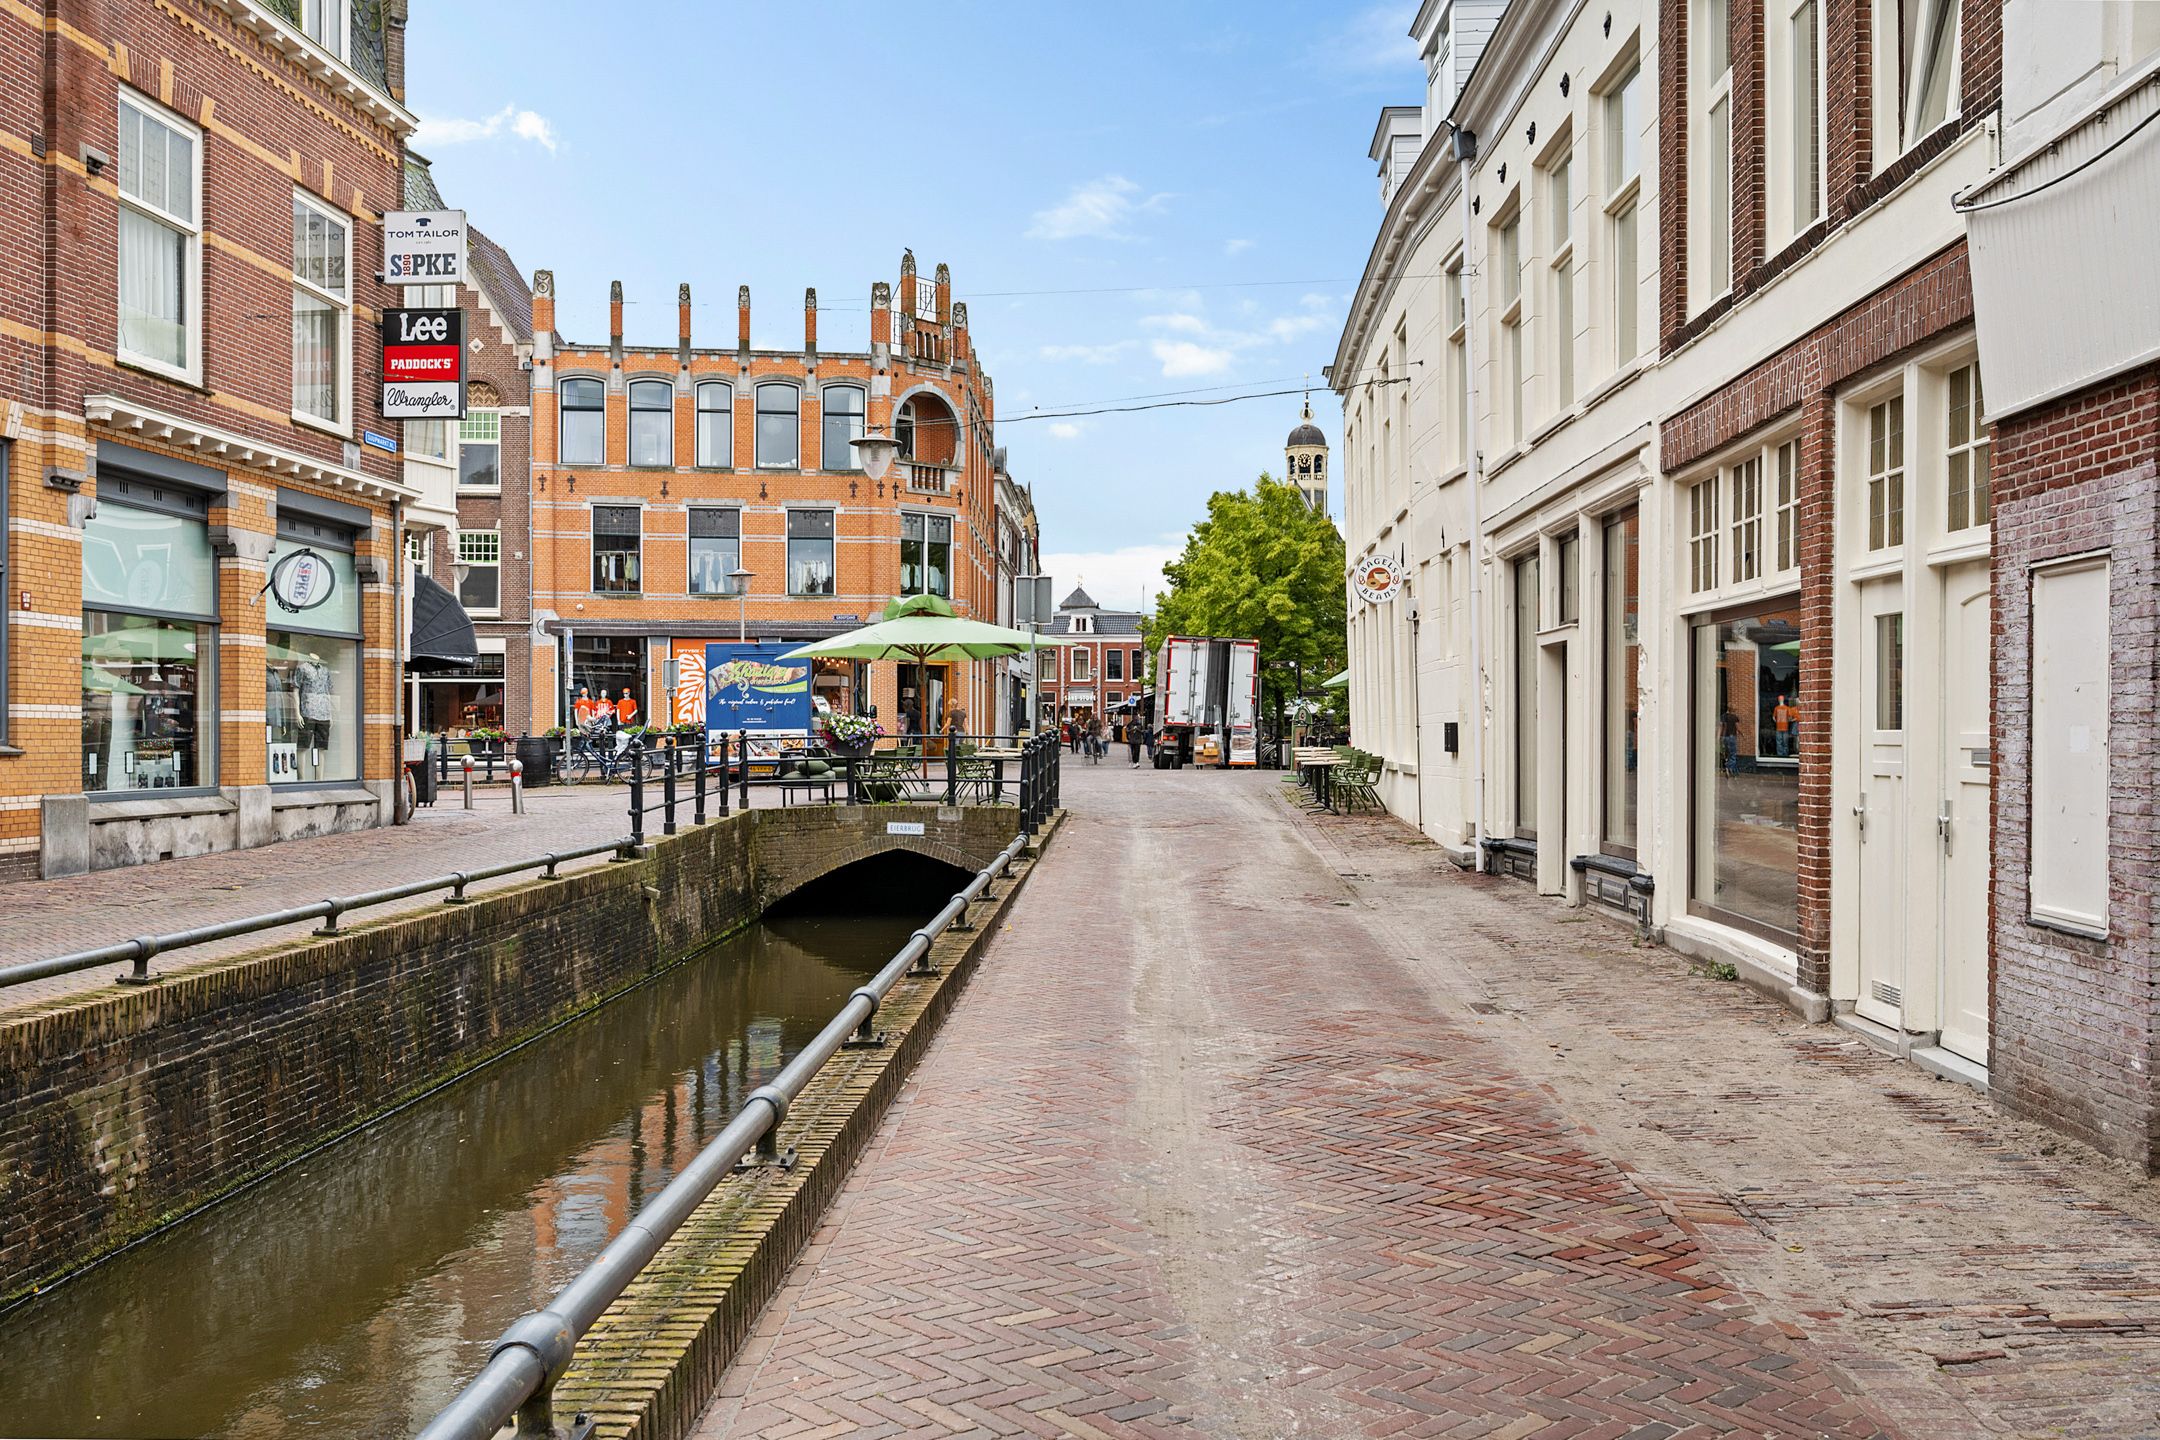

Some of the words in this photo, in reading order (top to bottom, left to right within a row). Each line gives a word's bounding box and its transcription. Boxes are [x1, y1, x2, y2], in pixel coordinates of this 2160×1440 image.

[416, 230, 459, 238] TAILOR
[400, 312, 447, 341] Lee
[391, 358, 452, 370] PADDOCK'S
[387, 388, 452, 412] Wrangler
[1360, 558, 1398, 573] BAGELS
[1362, 586, 1396, 600] BEANS
